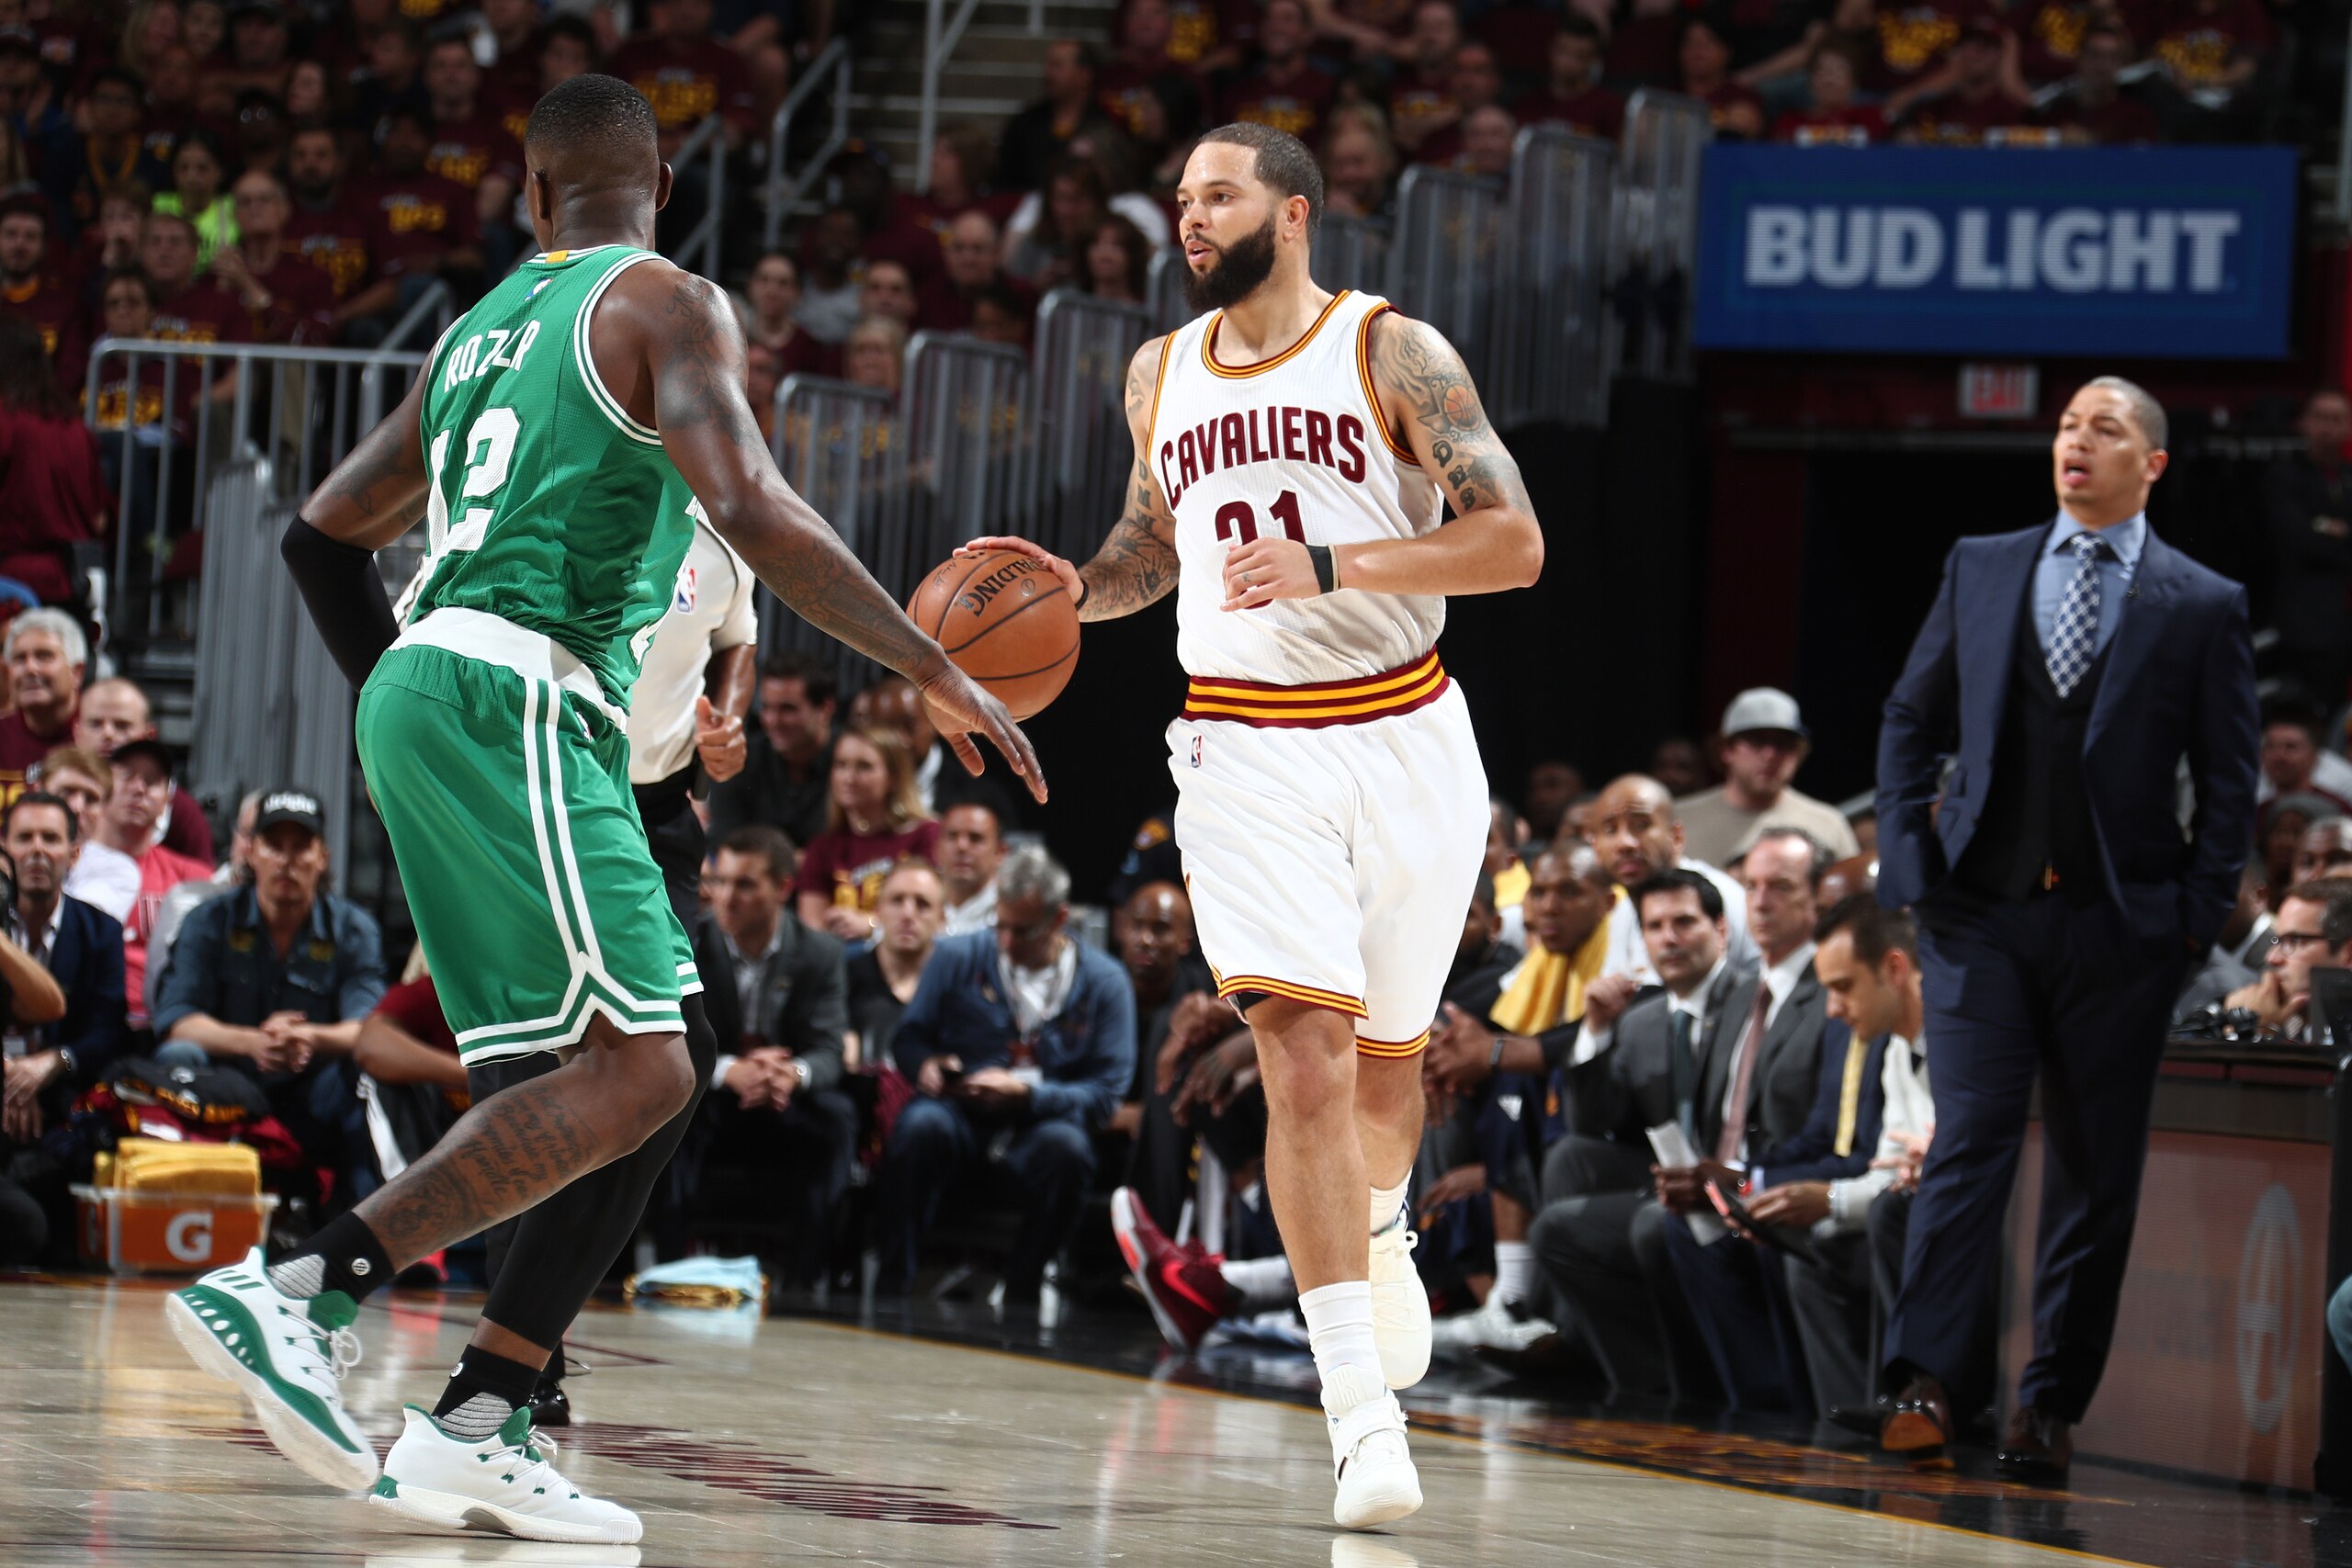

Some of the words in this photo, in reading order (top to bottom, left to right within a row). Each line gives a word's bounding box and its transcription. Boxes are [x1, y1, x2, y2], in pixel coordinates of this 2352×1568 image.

[1746, 208, 1945, 289] BUD
[1955, 208, 2240, 293] LIGHT
[424, 407, 522, 579] 12
[1161, 406, 1366, 512] CAVALIERS
[957, 557, 1051, 617] PALDING
[165, 1210, 213, 1263] G
